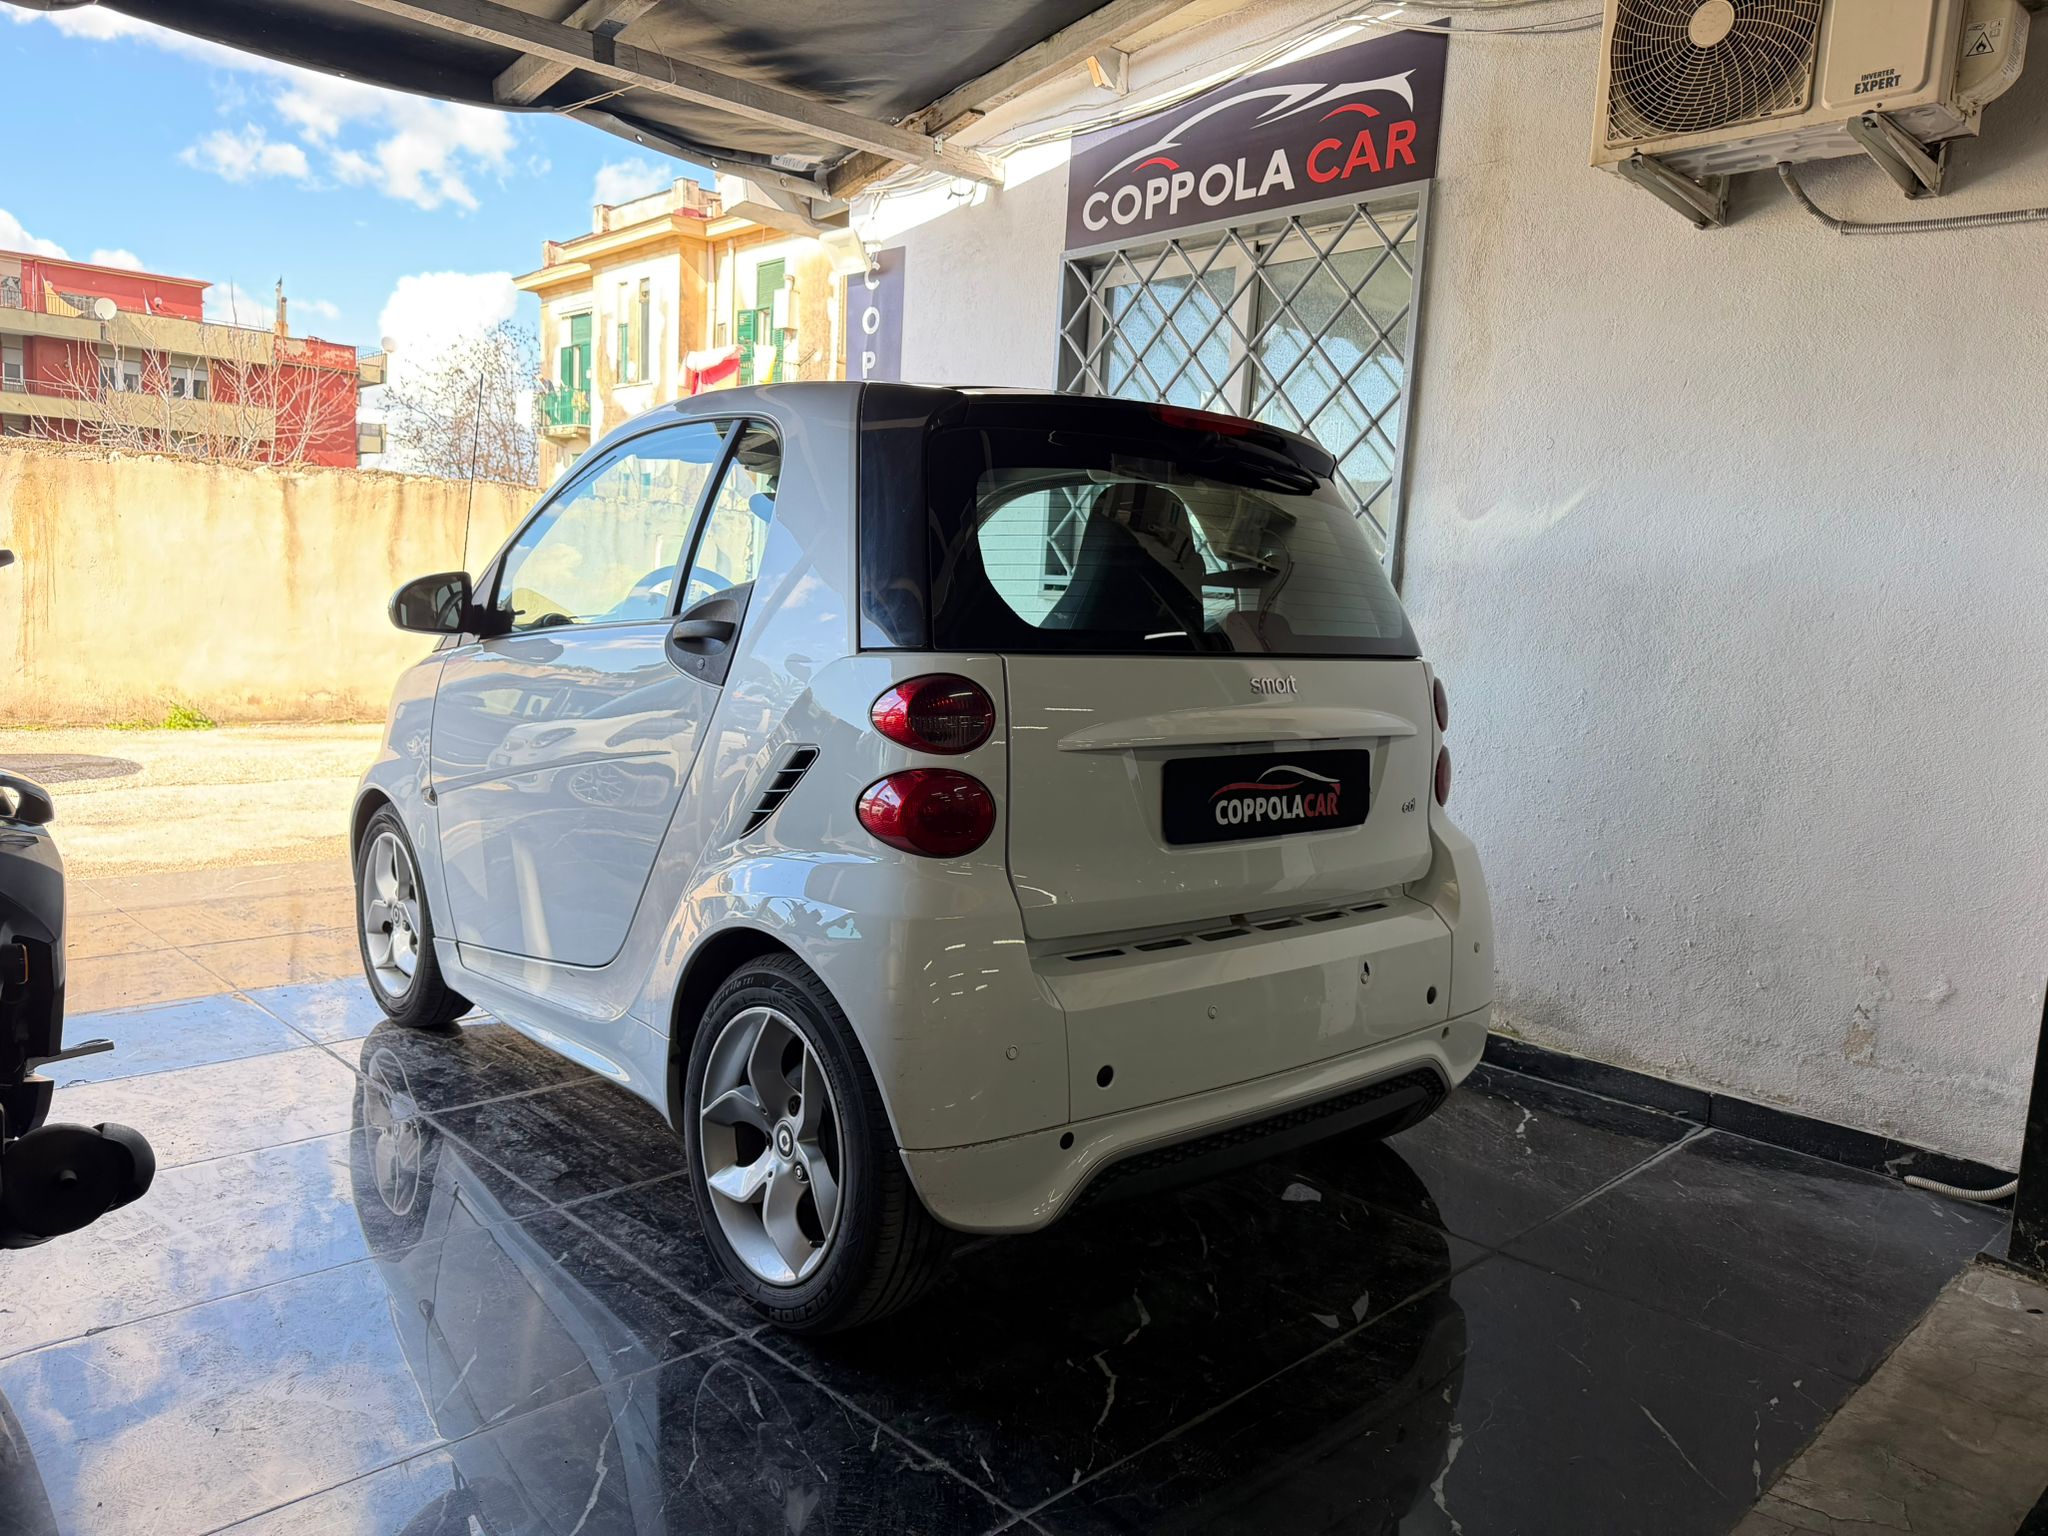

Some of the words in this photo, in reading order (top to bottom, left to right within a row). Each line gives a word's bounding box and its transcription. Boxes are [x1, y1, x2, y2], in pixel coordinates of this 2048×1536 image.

[1854, 74, 1901, 95] EXPERT
[1861, 68, 1895, 81] INVERTER
[1082, 148, 1295, 232] COPPOLA
[1306, 119, 1417, 183] CAR
[1250, 675, 1298, 694] smart
